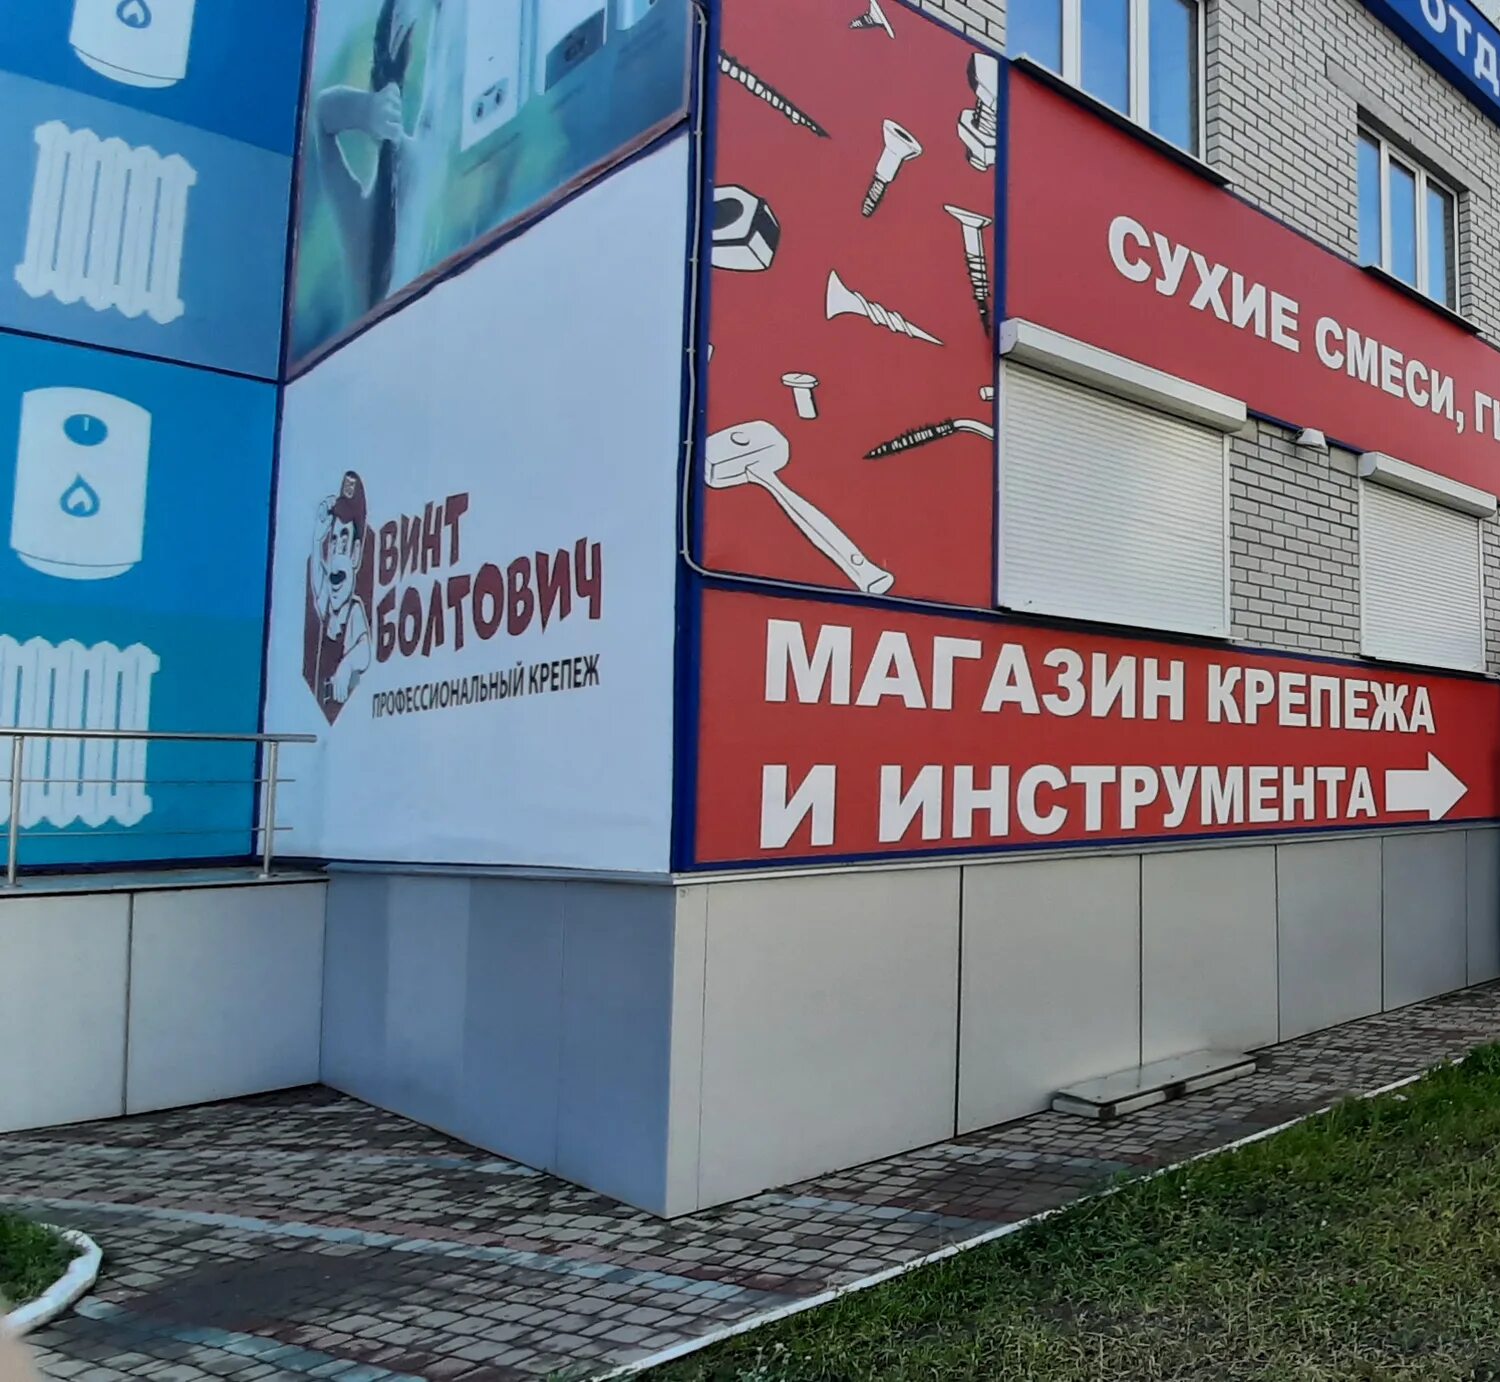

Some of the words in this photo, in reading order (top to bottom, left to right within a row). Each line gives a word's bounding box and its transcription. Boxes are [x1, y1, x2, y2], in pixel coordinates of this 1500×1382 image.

[1107, 215, 1301, 353] СУХИЕ
[1315, 316, 1466, 434] СМЕСИ,
[378, 492, 469, 587] ВИНТ
[376, 537, 602, 664] БОЛТОВИЧ
[372, 661, 525, 718] ПРОФЕССИОНАЛЬНЫЙ
[528, 654, 600, 695] КРЕПЕЖ
[764, 618, 1185, 721] МАГАЗИН
[1207, 664, 1437, 734] КРЕПЕЖА
[759, 764, 837, 850] И
[878, 765, 1378, 843] ИНСТРУМЕНТА
